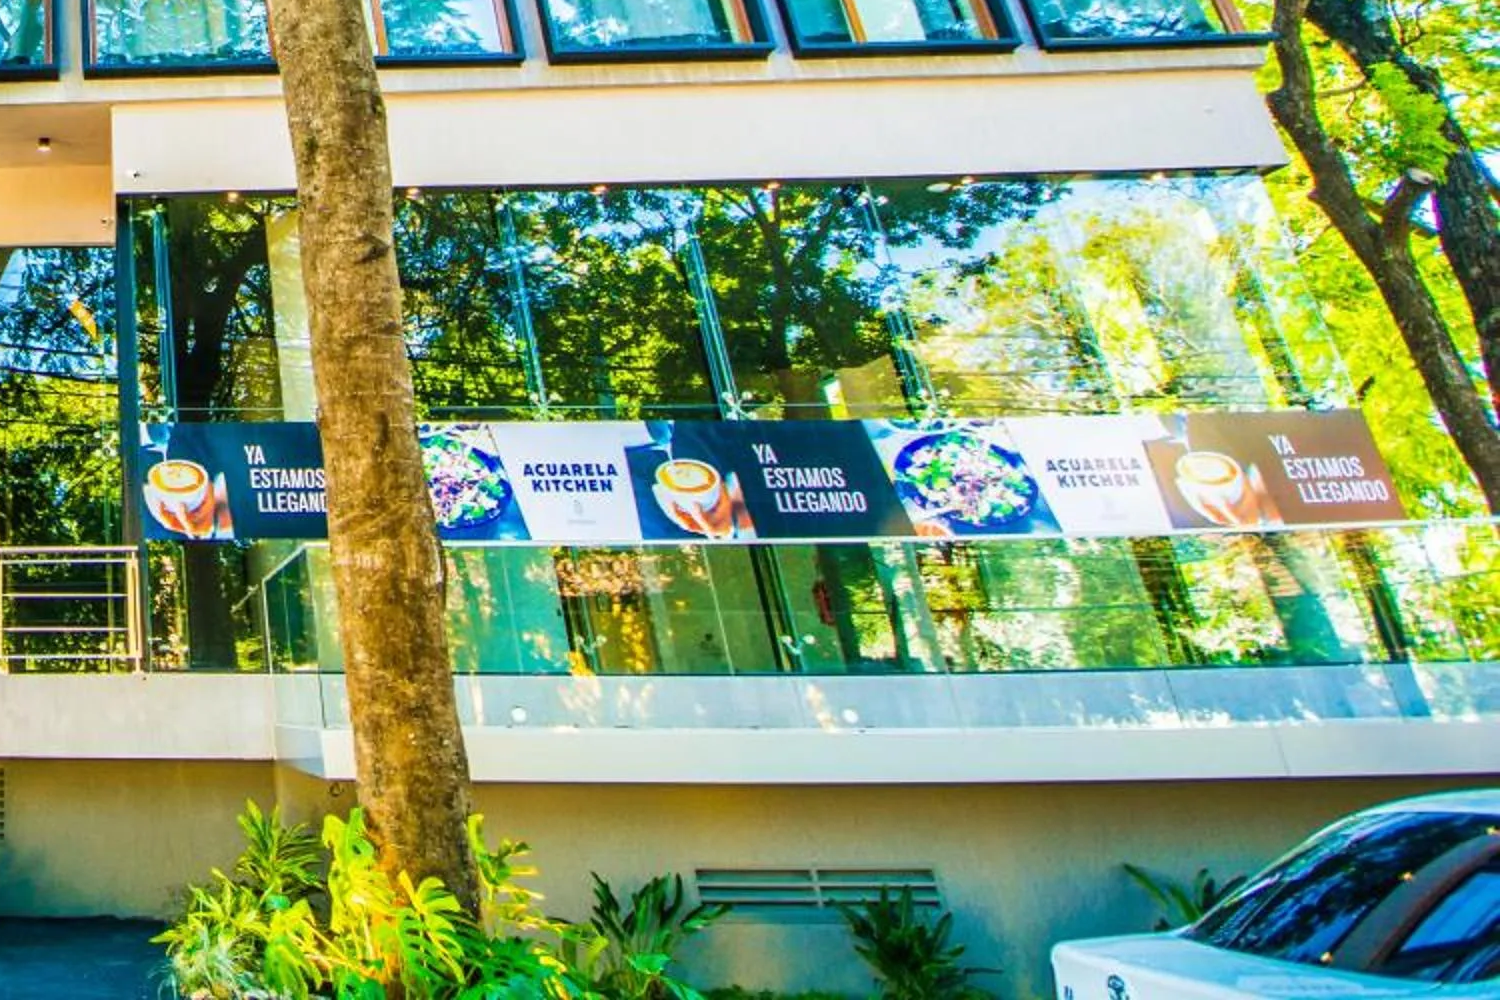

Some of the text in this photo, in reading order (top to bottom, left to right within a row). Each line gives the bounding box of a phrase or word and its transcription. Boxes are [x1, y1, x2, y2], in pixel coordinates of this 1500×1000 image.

[243, 444, 267, 465] YA
[751, 443, 778, 464] YA
[1267, 434, 1296, 455] YA
[523, 463, 619, 477] ACUARELA
[1045, 457, 1142, 472] ACUARELA
[1283, 456, 1365, 479] ESTAMOS
[249, 468, 326, 489] ESTAMOS
[531, 479, 614, 492] KITCHEN
[762, 467, 847, 489] ESTAMOS
[1055, 474, 1141, 488] KITCHEN
[257, 491, 329, 513] LLEGAND
[774, 491, 868, 513] LLEGANDO
[1297, 480, 1389, 503] LLEGANDO
